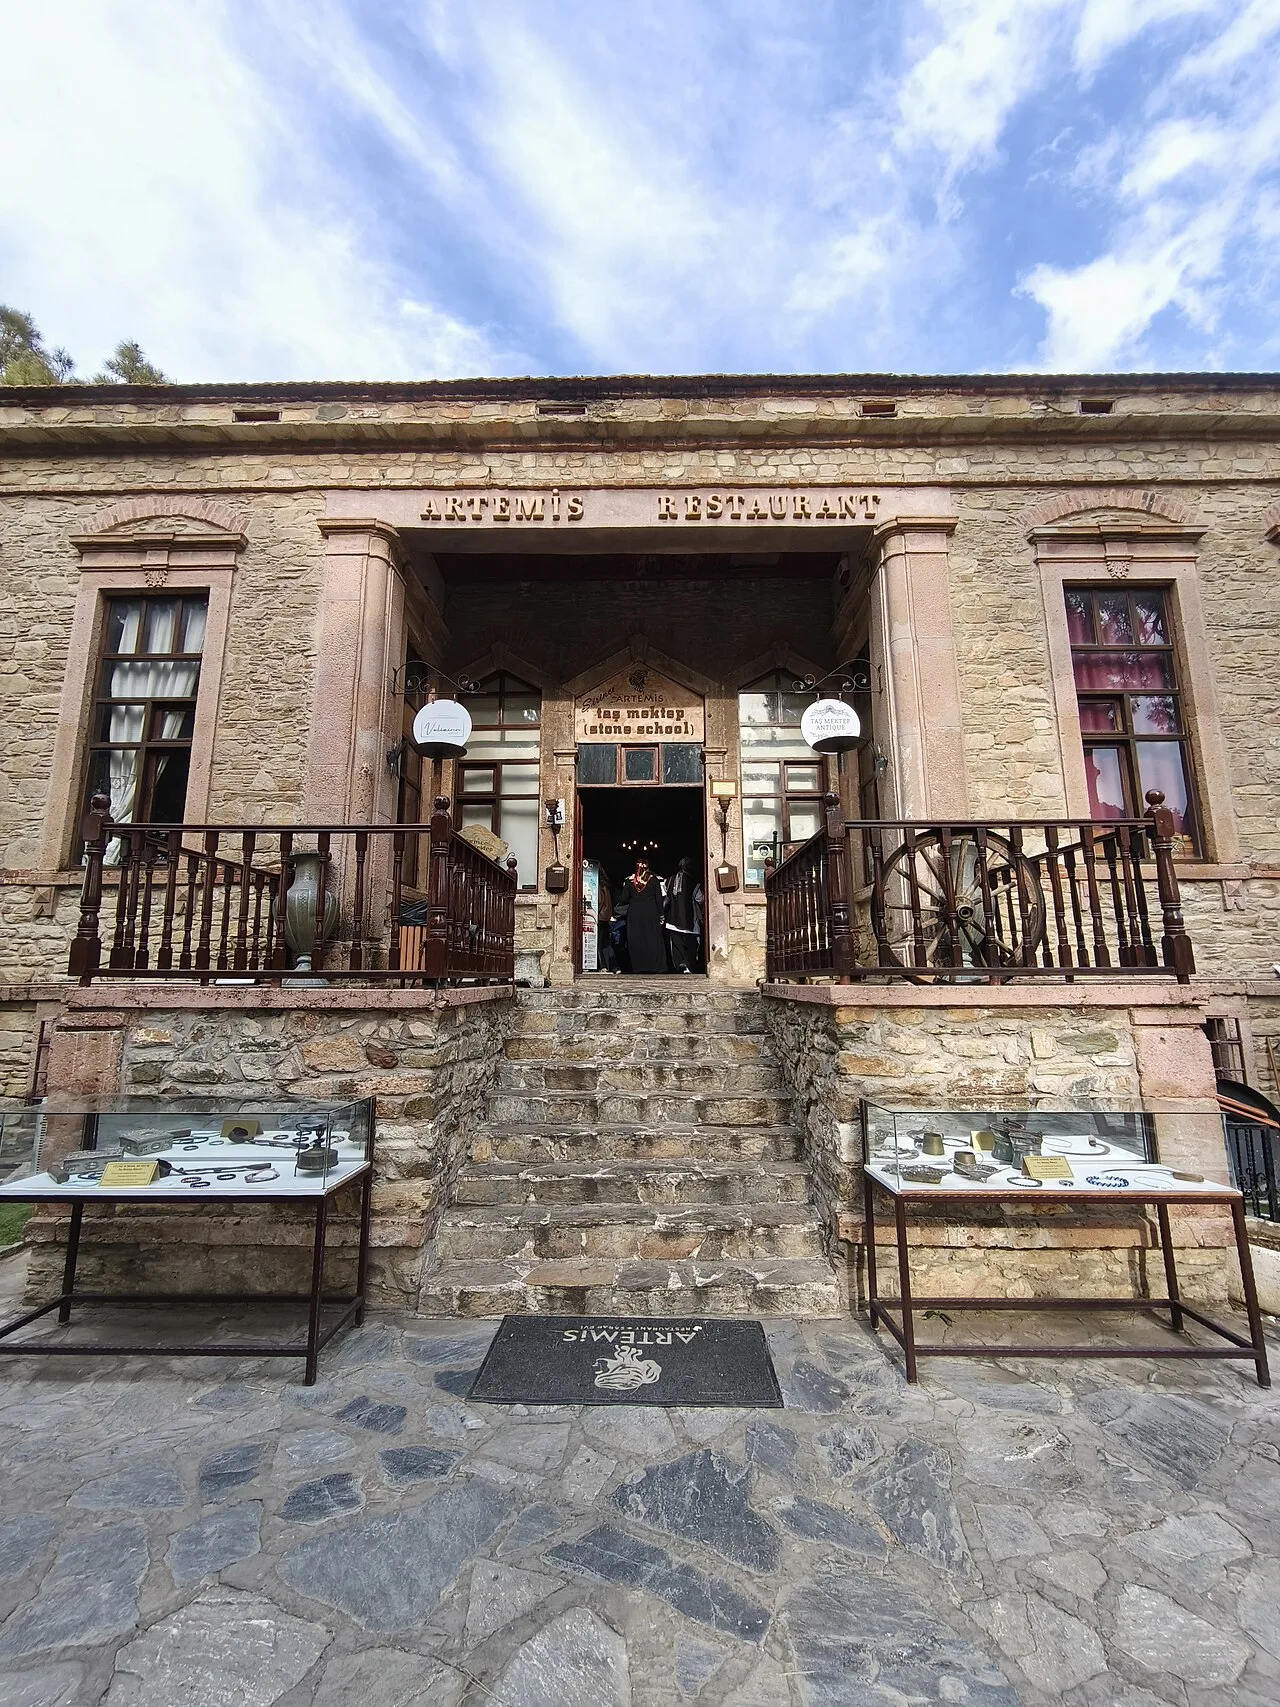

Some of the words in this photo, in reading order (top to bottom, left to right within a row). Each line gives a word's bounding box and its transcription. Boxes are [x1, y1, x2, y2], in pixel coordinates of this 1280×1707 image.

[658, 494, 880, 520] RESTAURANT
[627, 706, 685, 721] mektep
[584, 723, 632, 735] (stone
[637, 722, 694, 735] school)
